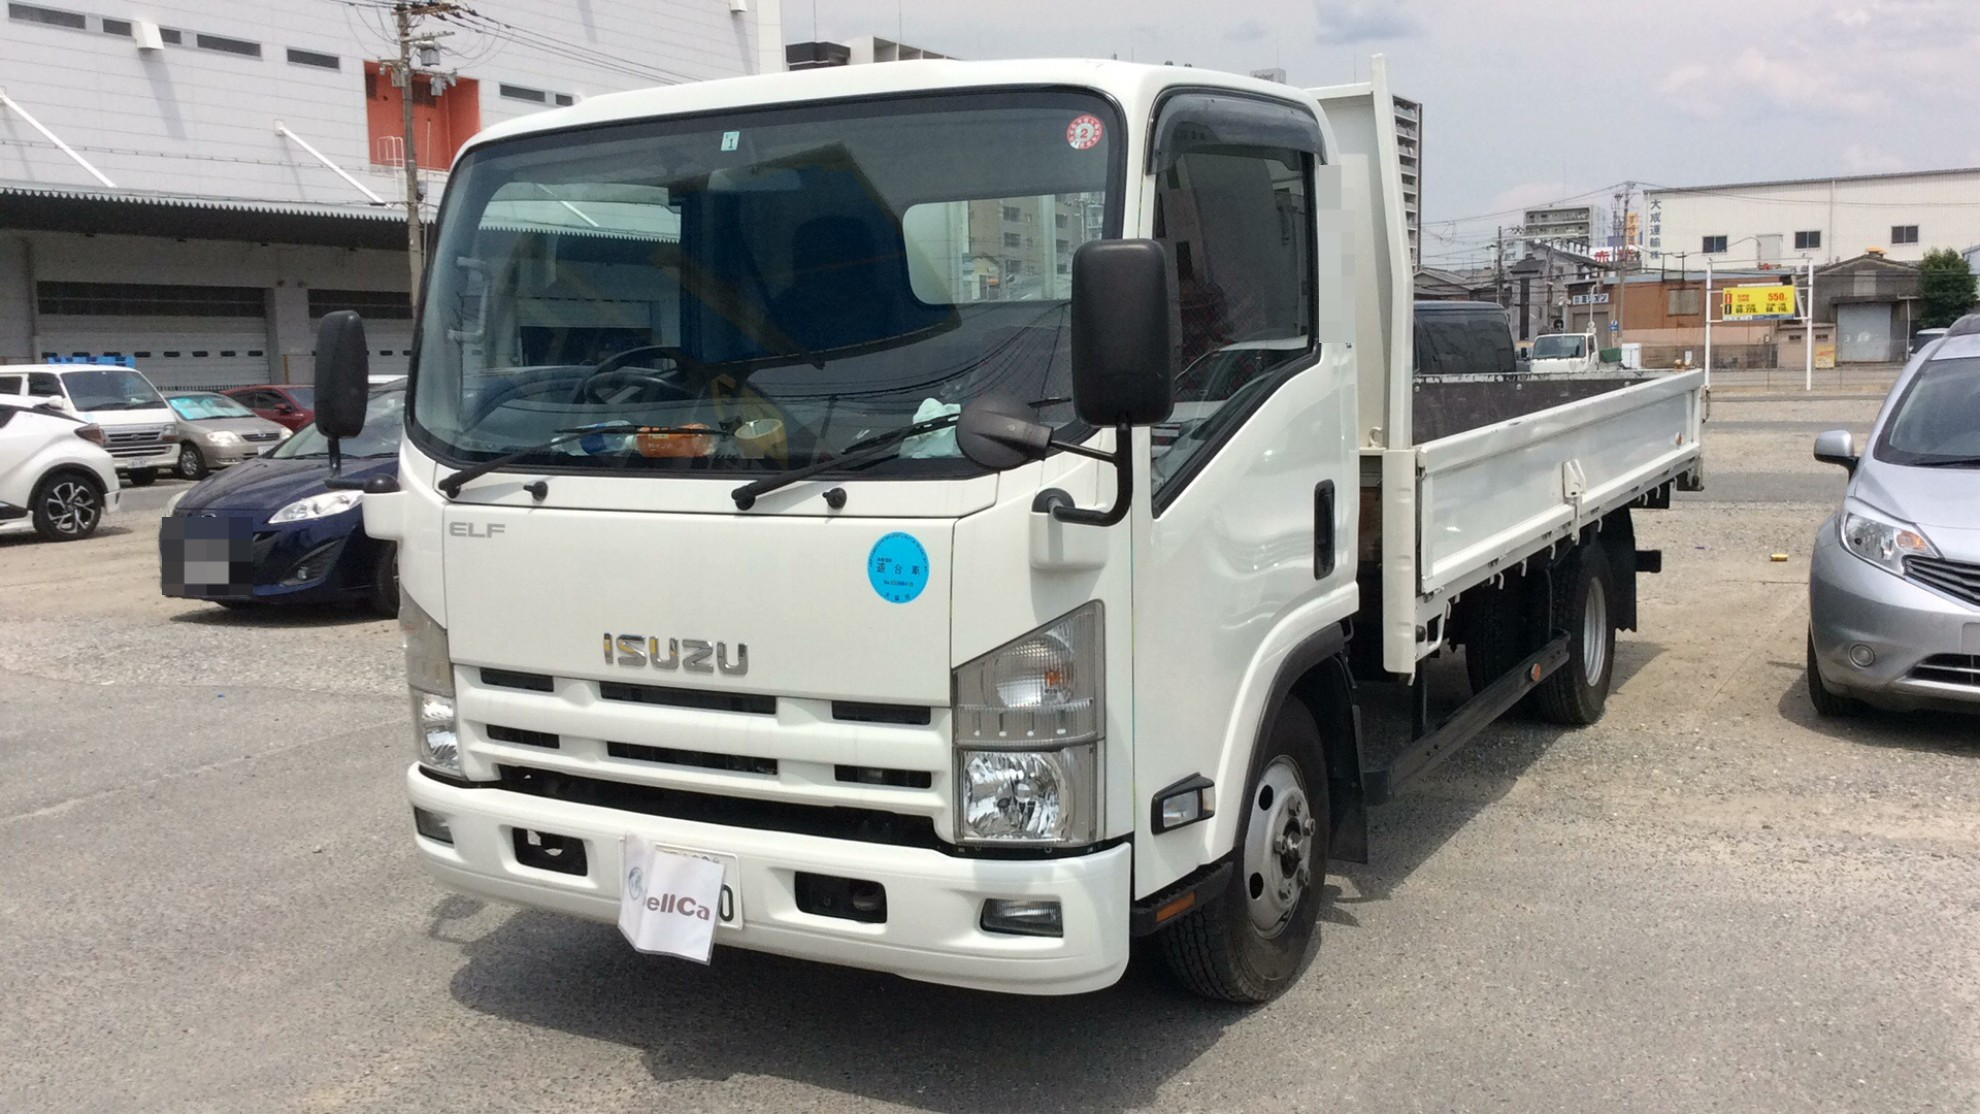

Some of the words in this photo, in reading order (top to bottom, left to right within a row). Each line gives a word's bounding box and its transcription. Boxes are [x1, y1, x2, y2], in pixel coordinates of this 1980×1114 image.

[449, 521, 506, 538] ELF
[603, 632, 749, 676] ISUZU
[644, 892, 711, 921] ellCa
